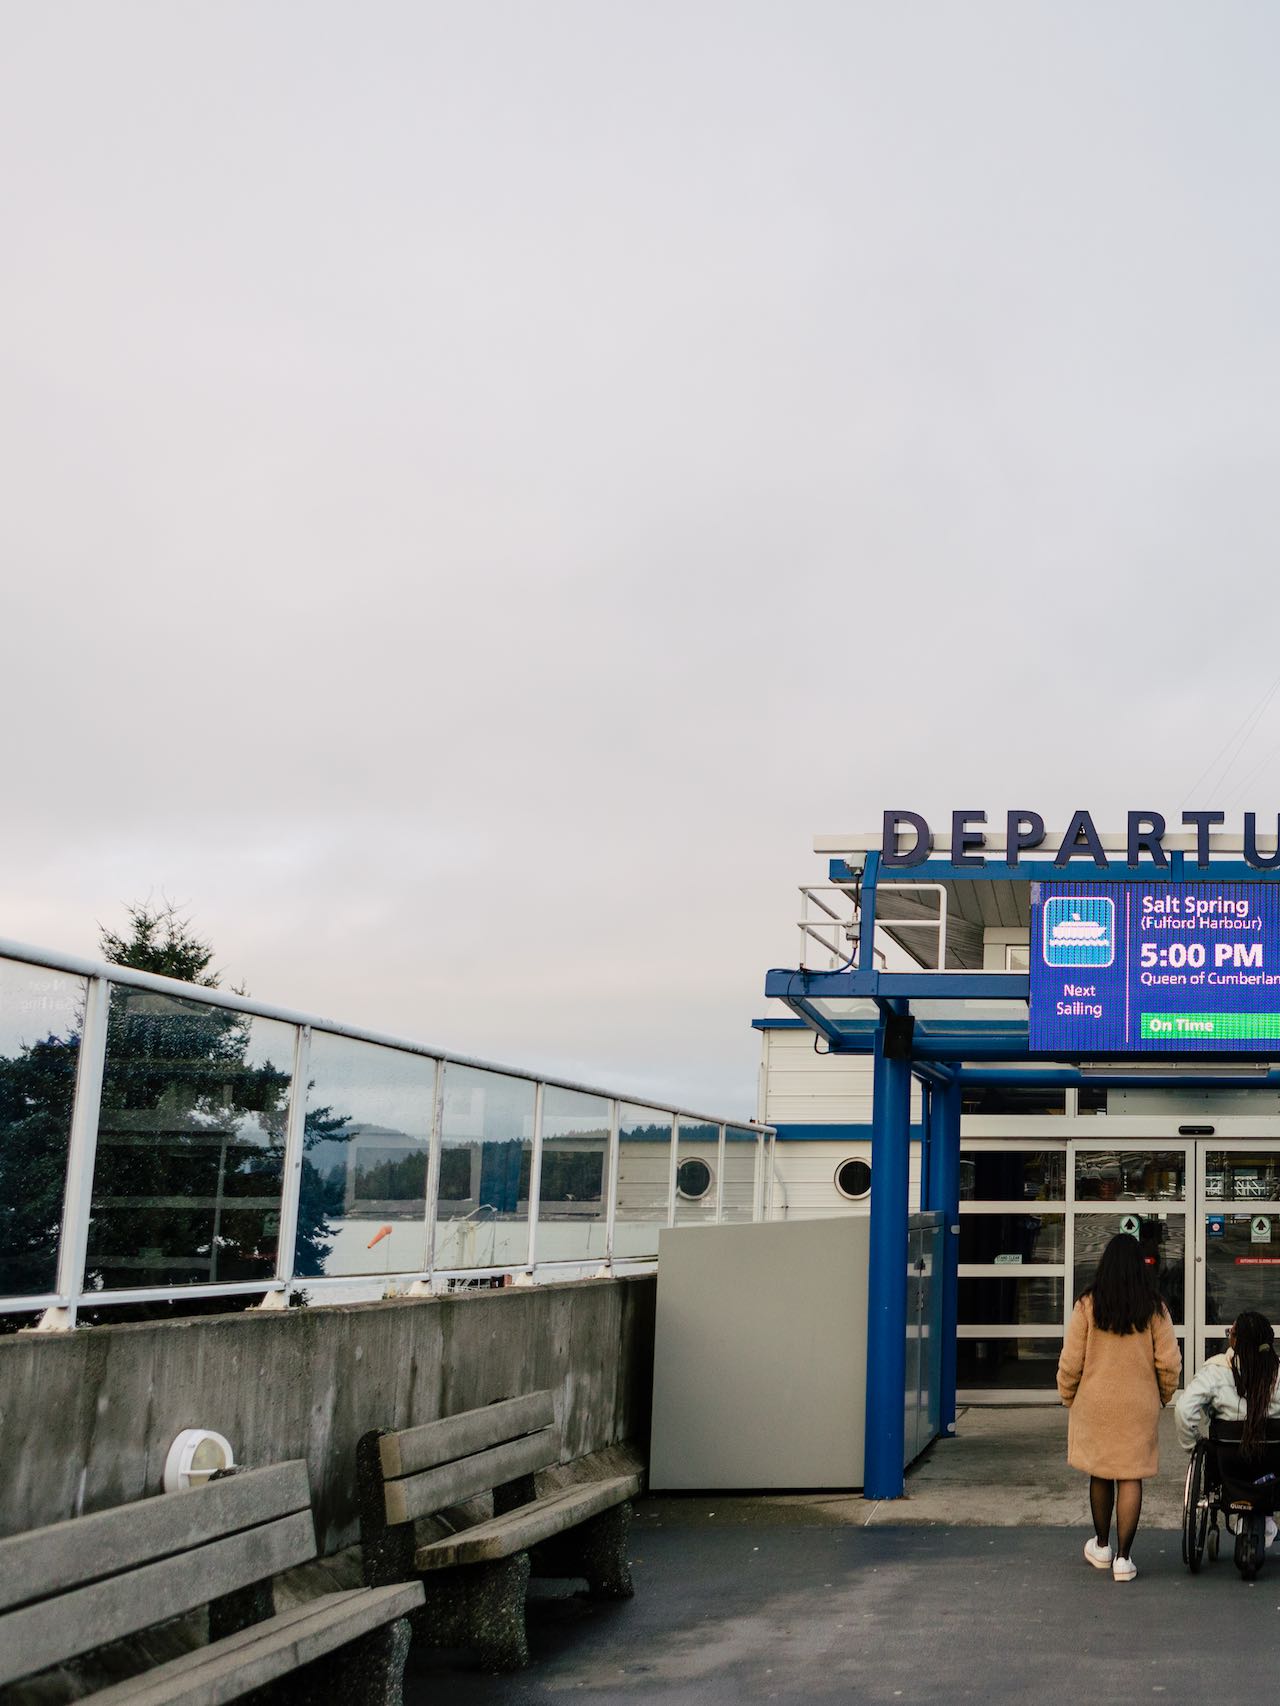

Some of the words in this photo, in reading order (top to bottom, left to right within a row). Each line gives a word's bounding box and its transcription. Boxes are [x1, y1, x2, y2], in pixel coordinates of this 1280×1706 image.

[1142, 896, 1180, 913] Salt
[1184, 896, 1249, 917] Spring
[1141, 916, 1195, 931] (Fulford
[1199, 916, 1262, 931] Harbour)
[1141, 943, 1206, 968] 5:00
[1215, 943, 1263, 968] PM
[1140, 972, 1186, 986] Queen
[1190, 972, 1205, 984] of
[1063, 984, 1096, 997] Next
[1056, 1002, 1103, 1018] Sailing
[1149, 1018, 1172, 1032] On
[1176, 1018, 1215, 1032] Time
